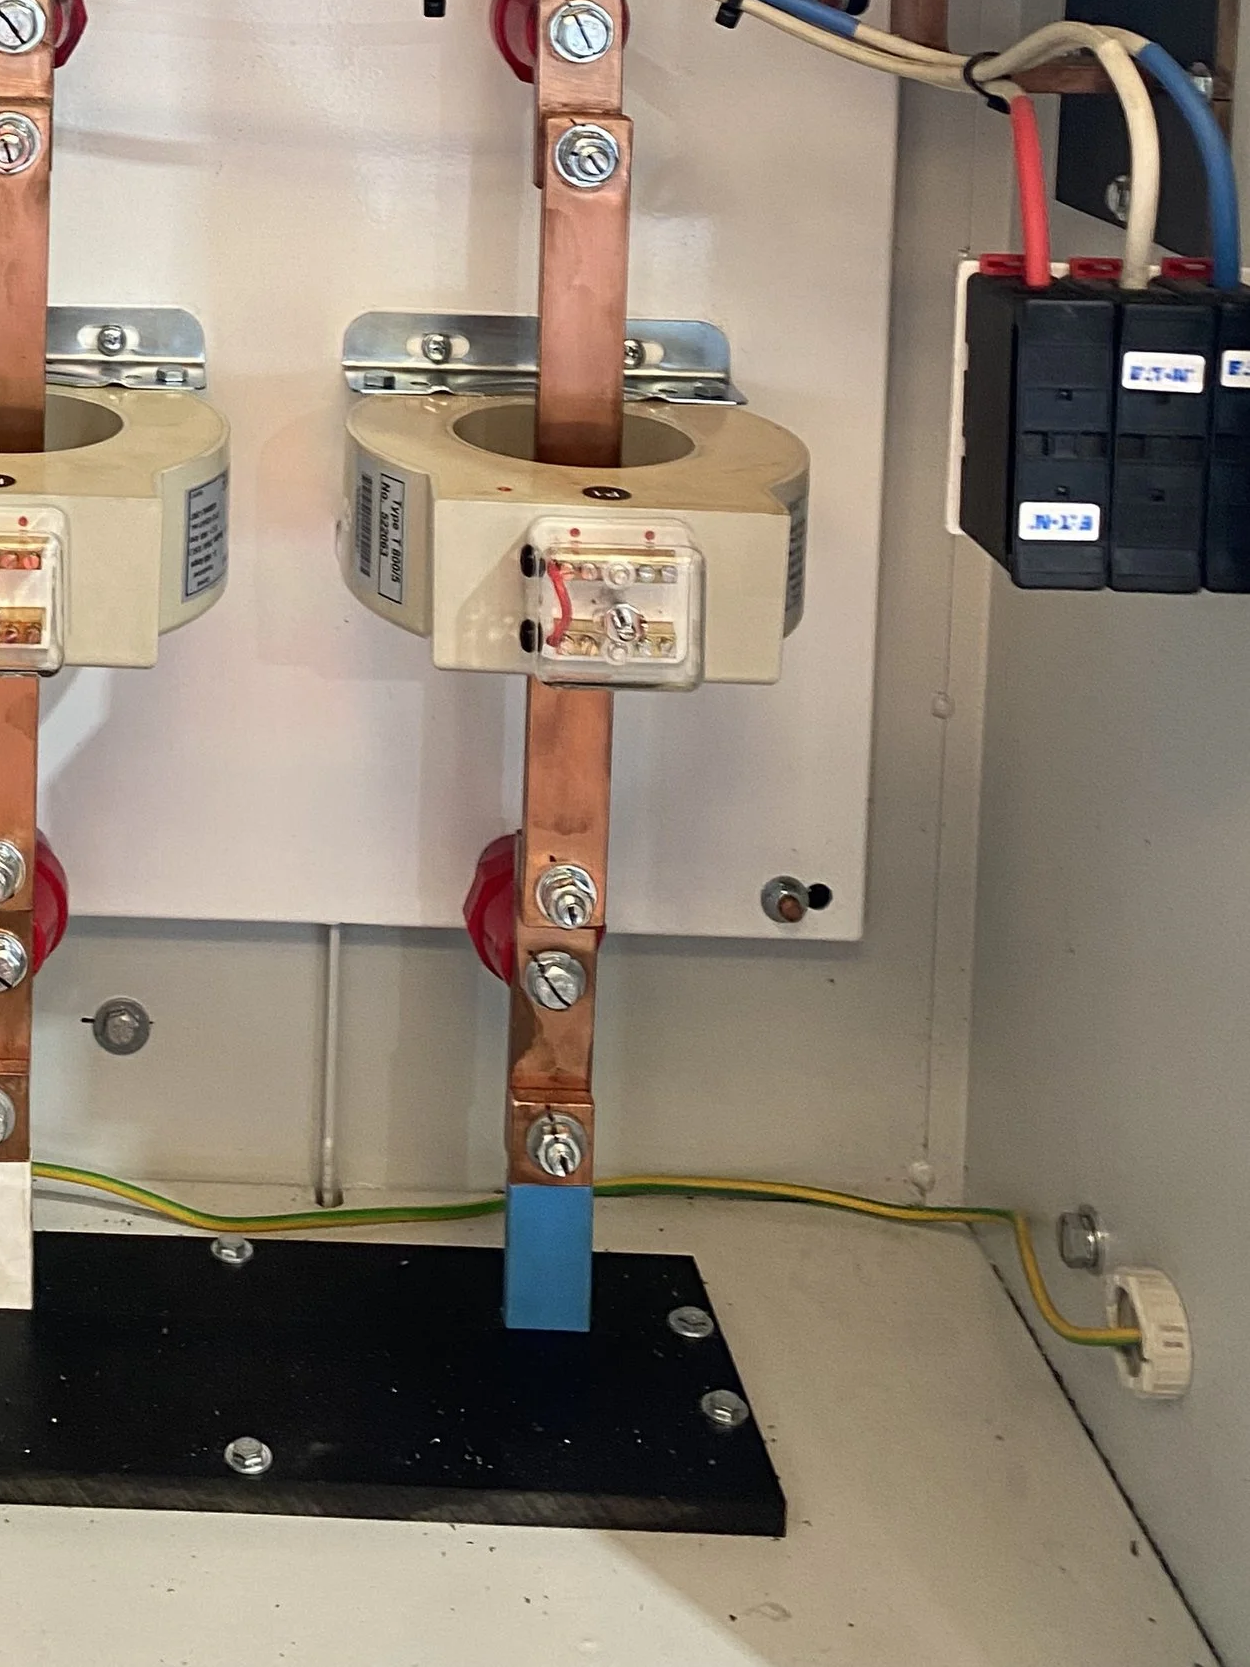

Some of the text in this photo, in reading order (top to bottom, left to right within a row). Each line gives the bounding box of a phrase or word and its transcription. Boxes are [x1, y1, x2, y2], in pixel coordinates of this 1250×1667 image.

[391, 500, 402, 583] Type T 800/5
